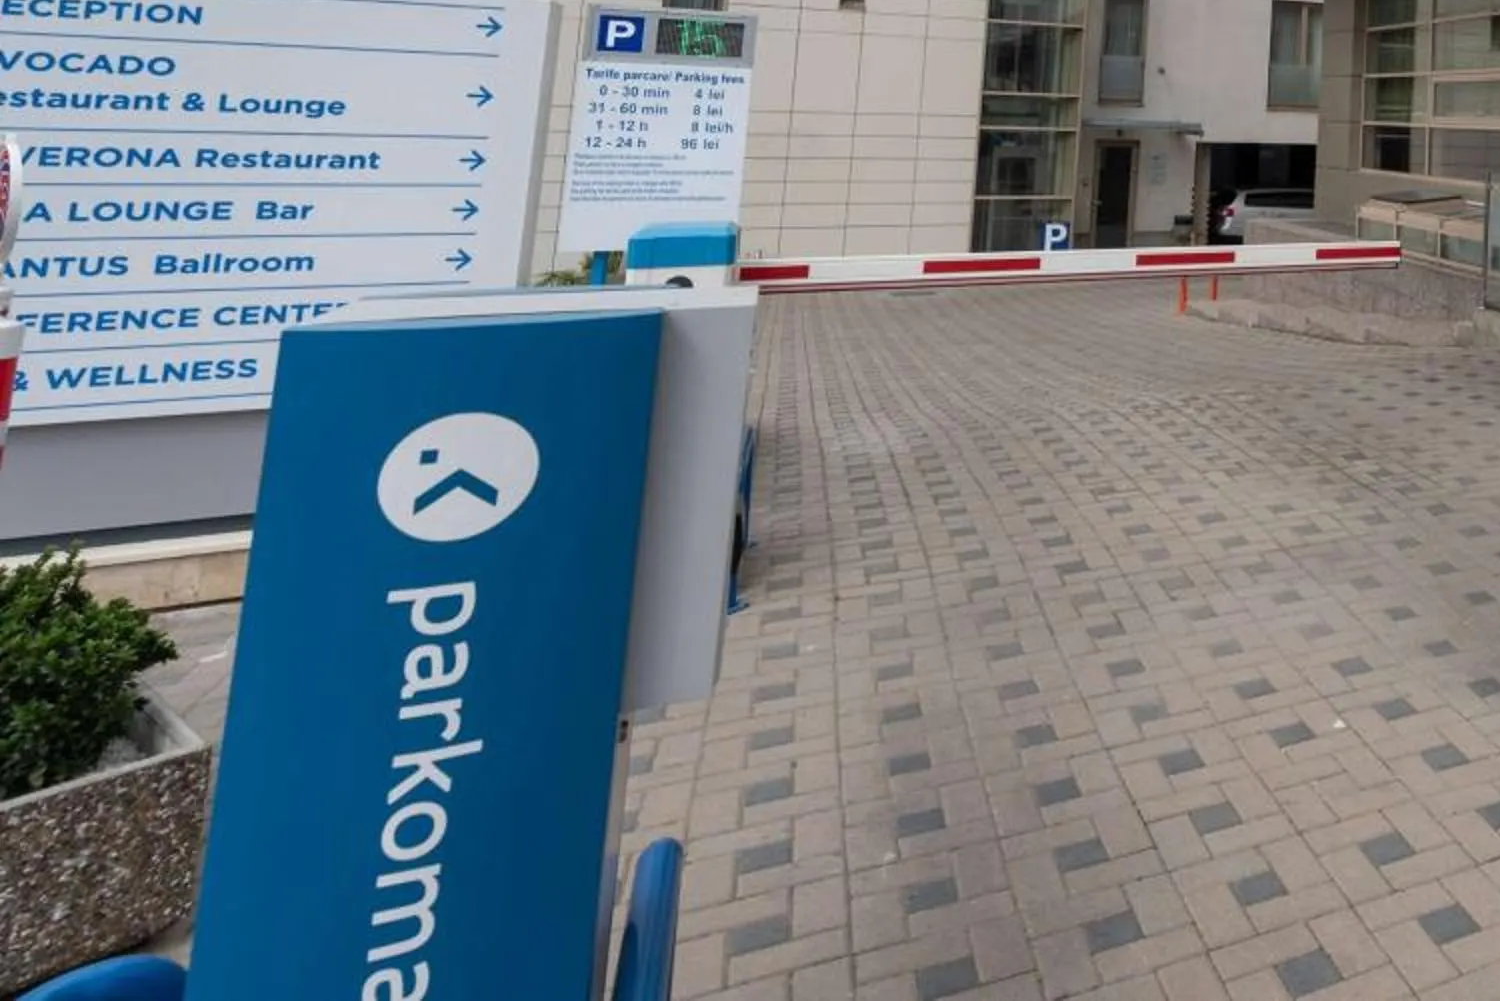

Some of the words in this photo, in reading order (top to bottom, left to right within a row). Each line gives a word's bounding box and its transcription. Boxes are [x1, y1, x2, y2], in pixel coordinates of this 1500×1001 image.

[605, 19, 638, 49] P
[0, 50, 176, 77] VOCADO
[675, 72, 719, 85] Parking
[622, 86, 639, 98] 30
[643, 87, 670, 98] min
[182, 92, 205, 113] &
[217, 93, 347, 120] Lounge
[588, 102, 606, 114] 31
[619, 102, 637, 114] 60
[641, 104, 669, 115] min
[619, 120, 636, 132] 12
[586, 136, 601, 148] 12
[616, 137, 633, 148] 24
[703, 139, 720, 150] lei
[194, 147, 381, 171] Restaurant
[67, 200, 234, 223] LOUNGE
[254, 199, 314, 223] Bar
[1043, 223, 1067, 252] P
[154, 252, 315, 277] Ballroom
[213, 302, 349, 327] CENTE
[45, 357, 259, 391] WELLNESS
